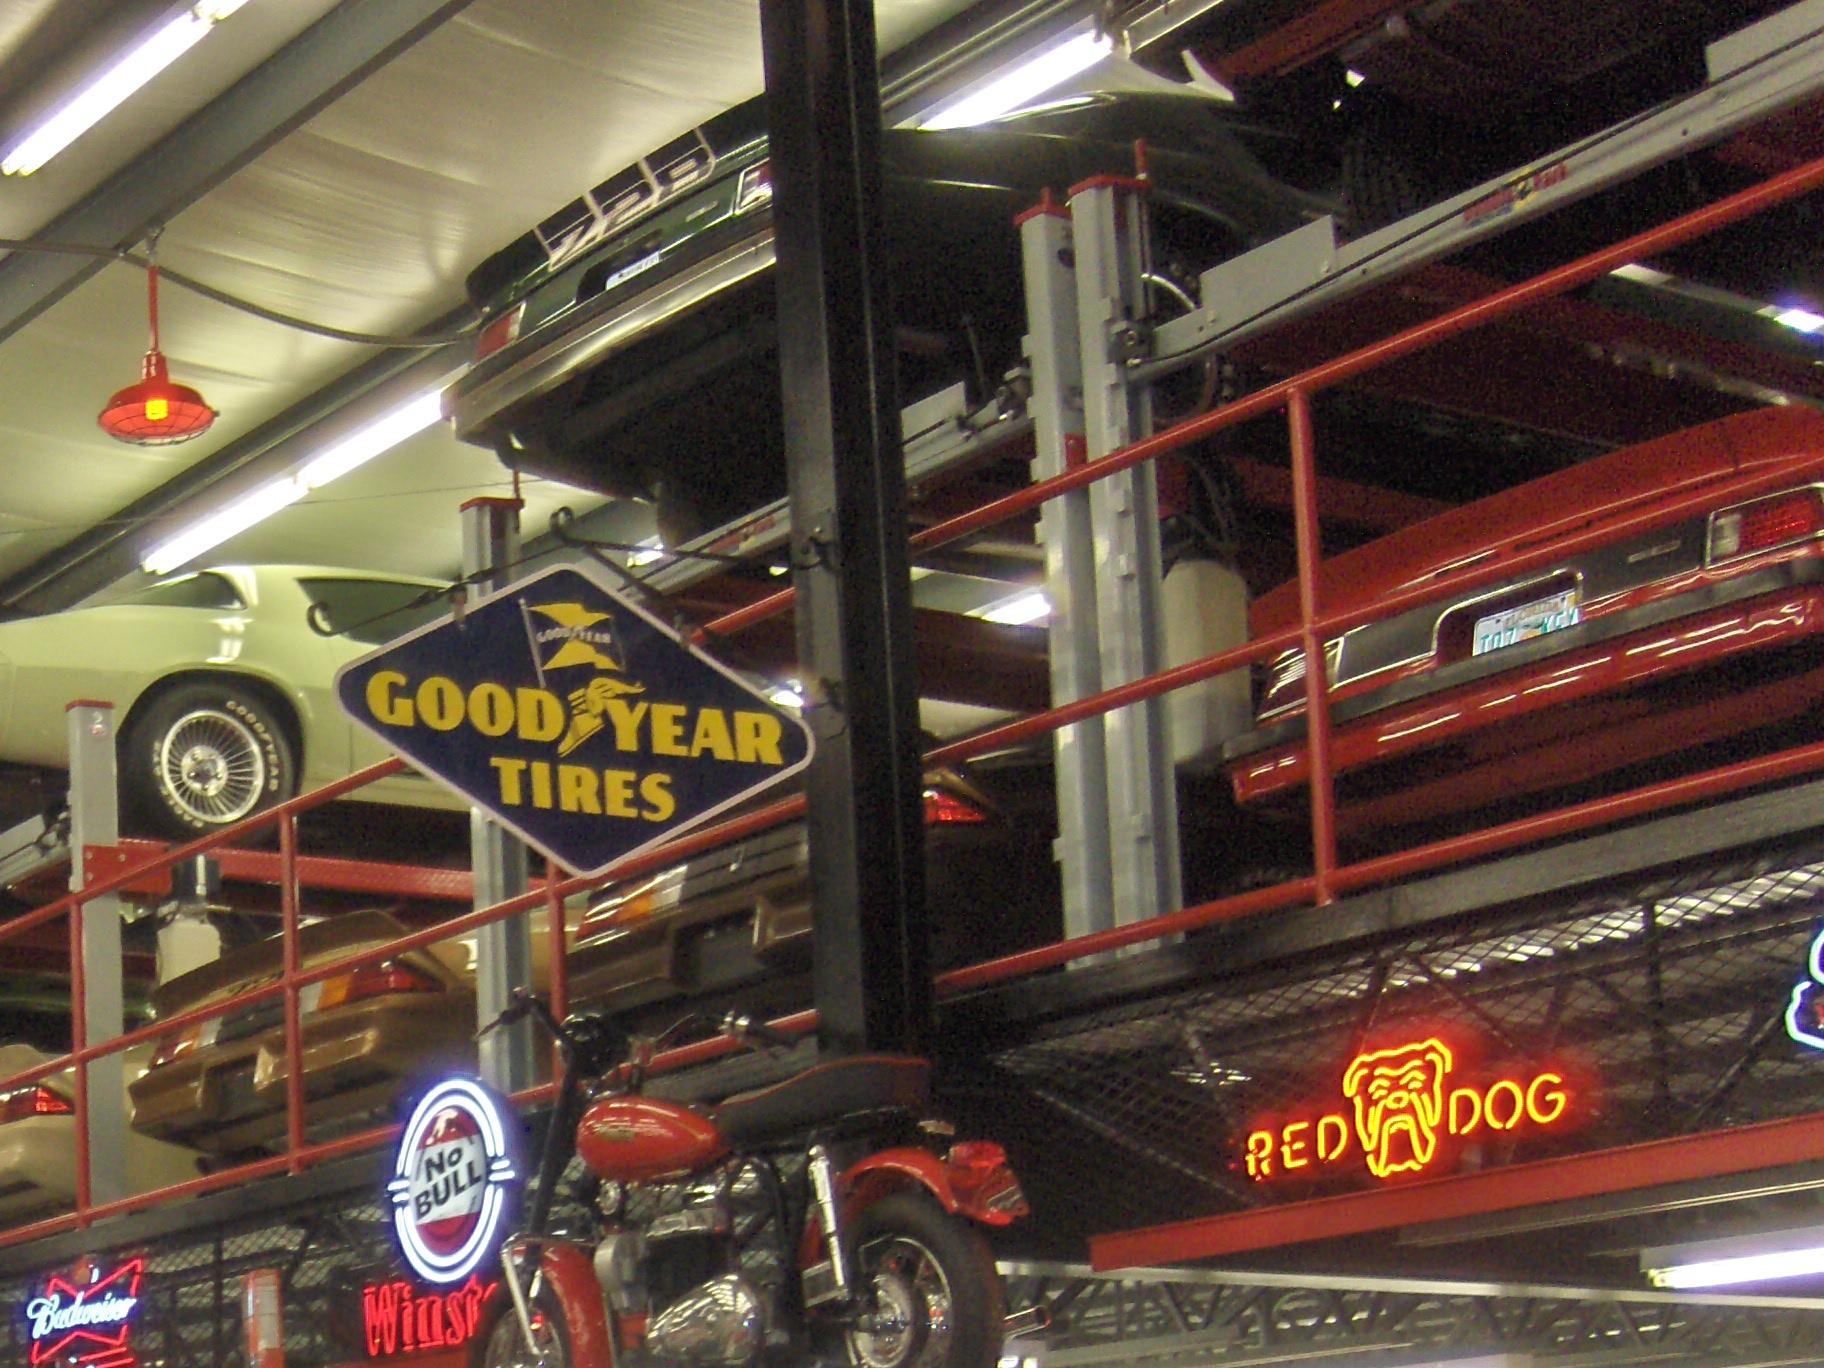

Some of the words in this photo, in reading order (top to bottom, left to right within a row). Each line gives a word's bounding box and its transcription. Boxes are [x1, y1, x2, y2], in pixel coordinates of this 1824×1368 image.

[489, 756, 675, 823] TIRES
[1245, 1114, 1348, 1181] RED
[1448, 1072, 1566, 1136] DOG
[413, 1159, 483, 1218] BULL
[426, 1146, 464, 1182] No
[26, 1291, 137, 1339] Budweiser
